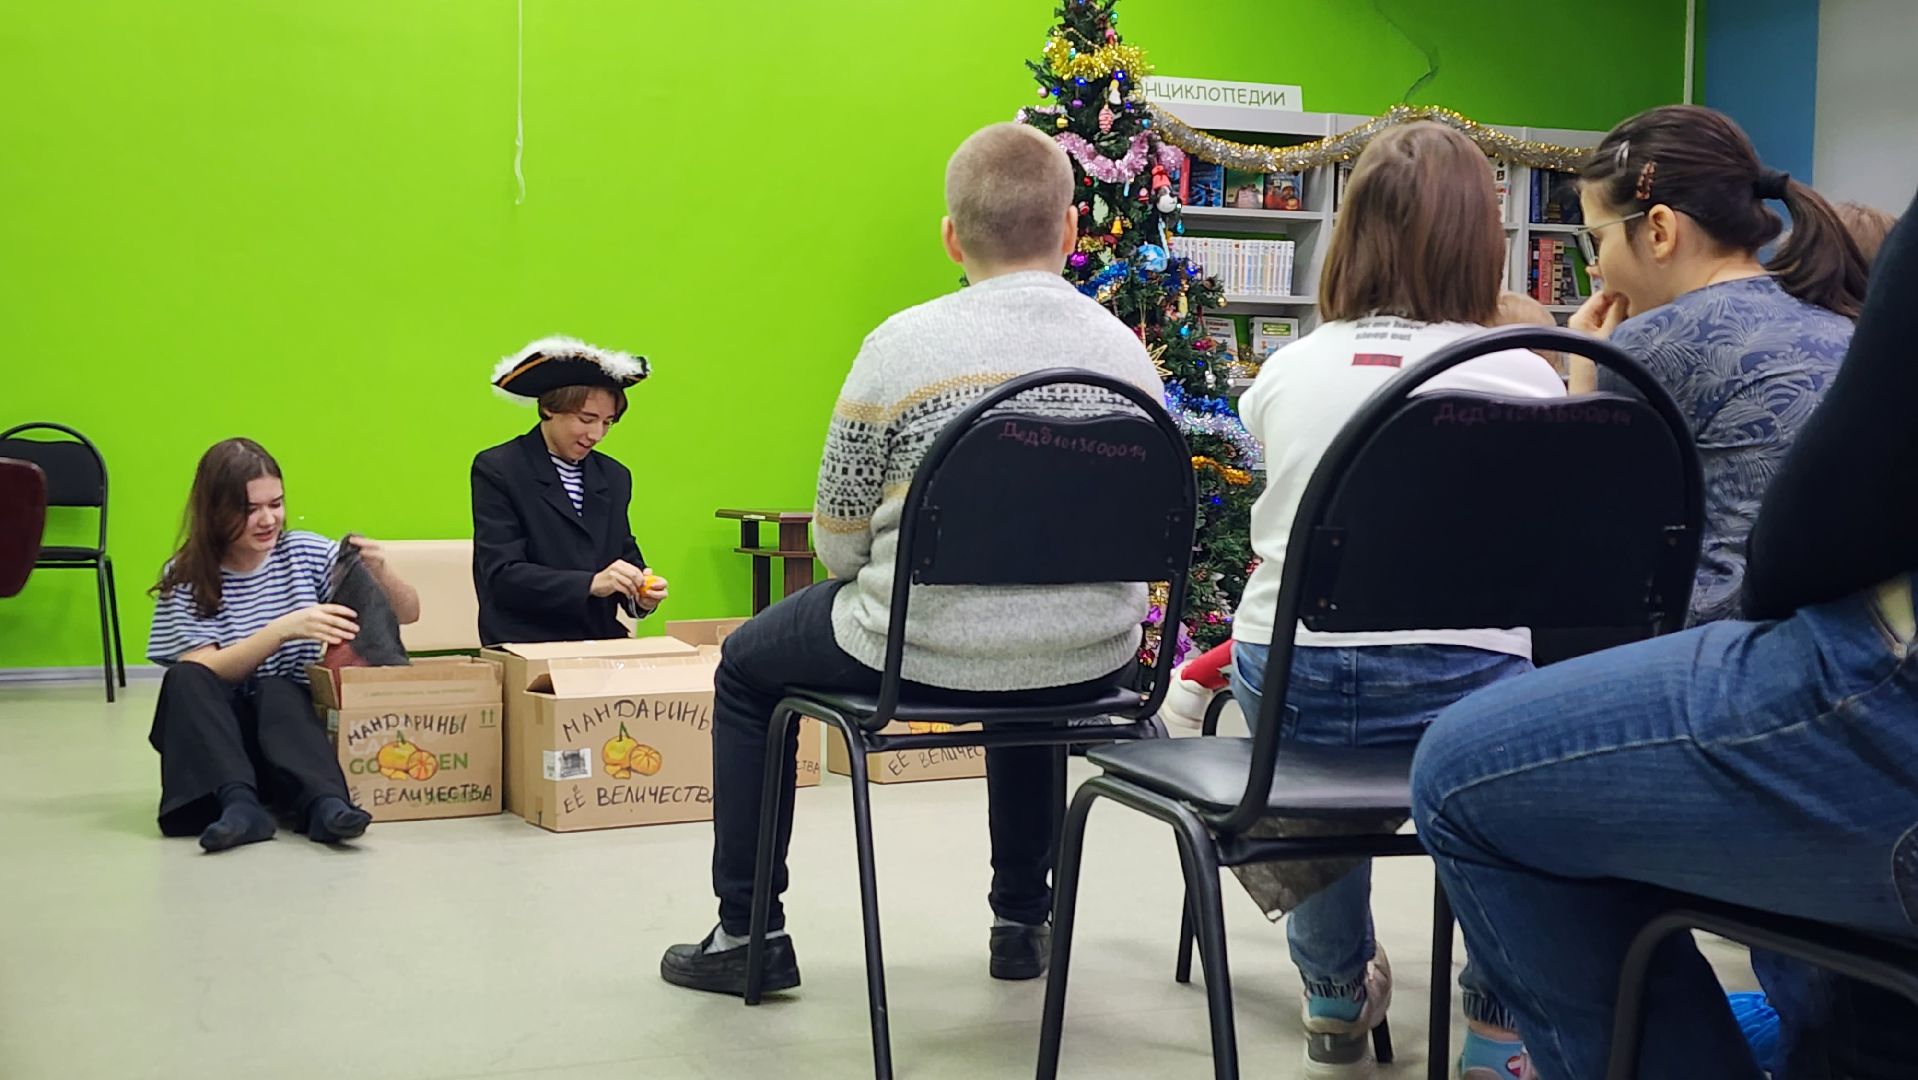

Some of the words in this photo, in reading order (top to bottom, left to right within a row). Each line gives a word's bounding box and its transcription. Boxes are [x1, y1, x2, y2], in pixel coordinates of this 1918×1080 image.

[347, 713, 468, 746] МАНДАРИНЫ
[917, 746, 984, 769] ВЕЛИЧЕС
[373, 783, 492, 806] ВЕЛИЧЕСТВА
